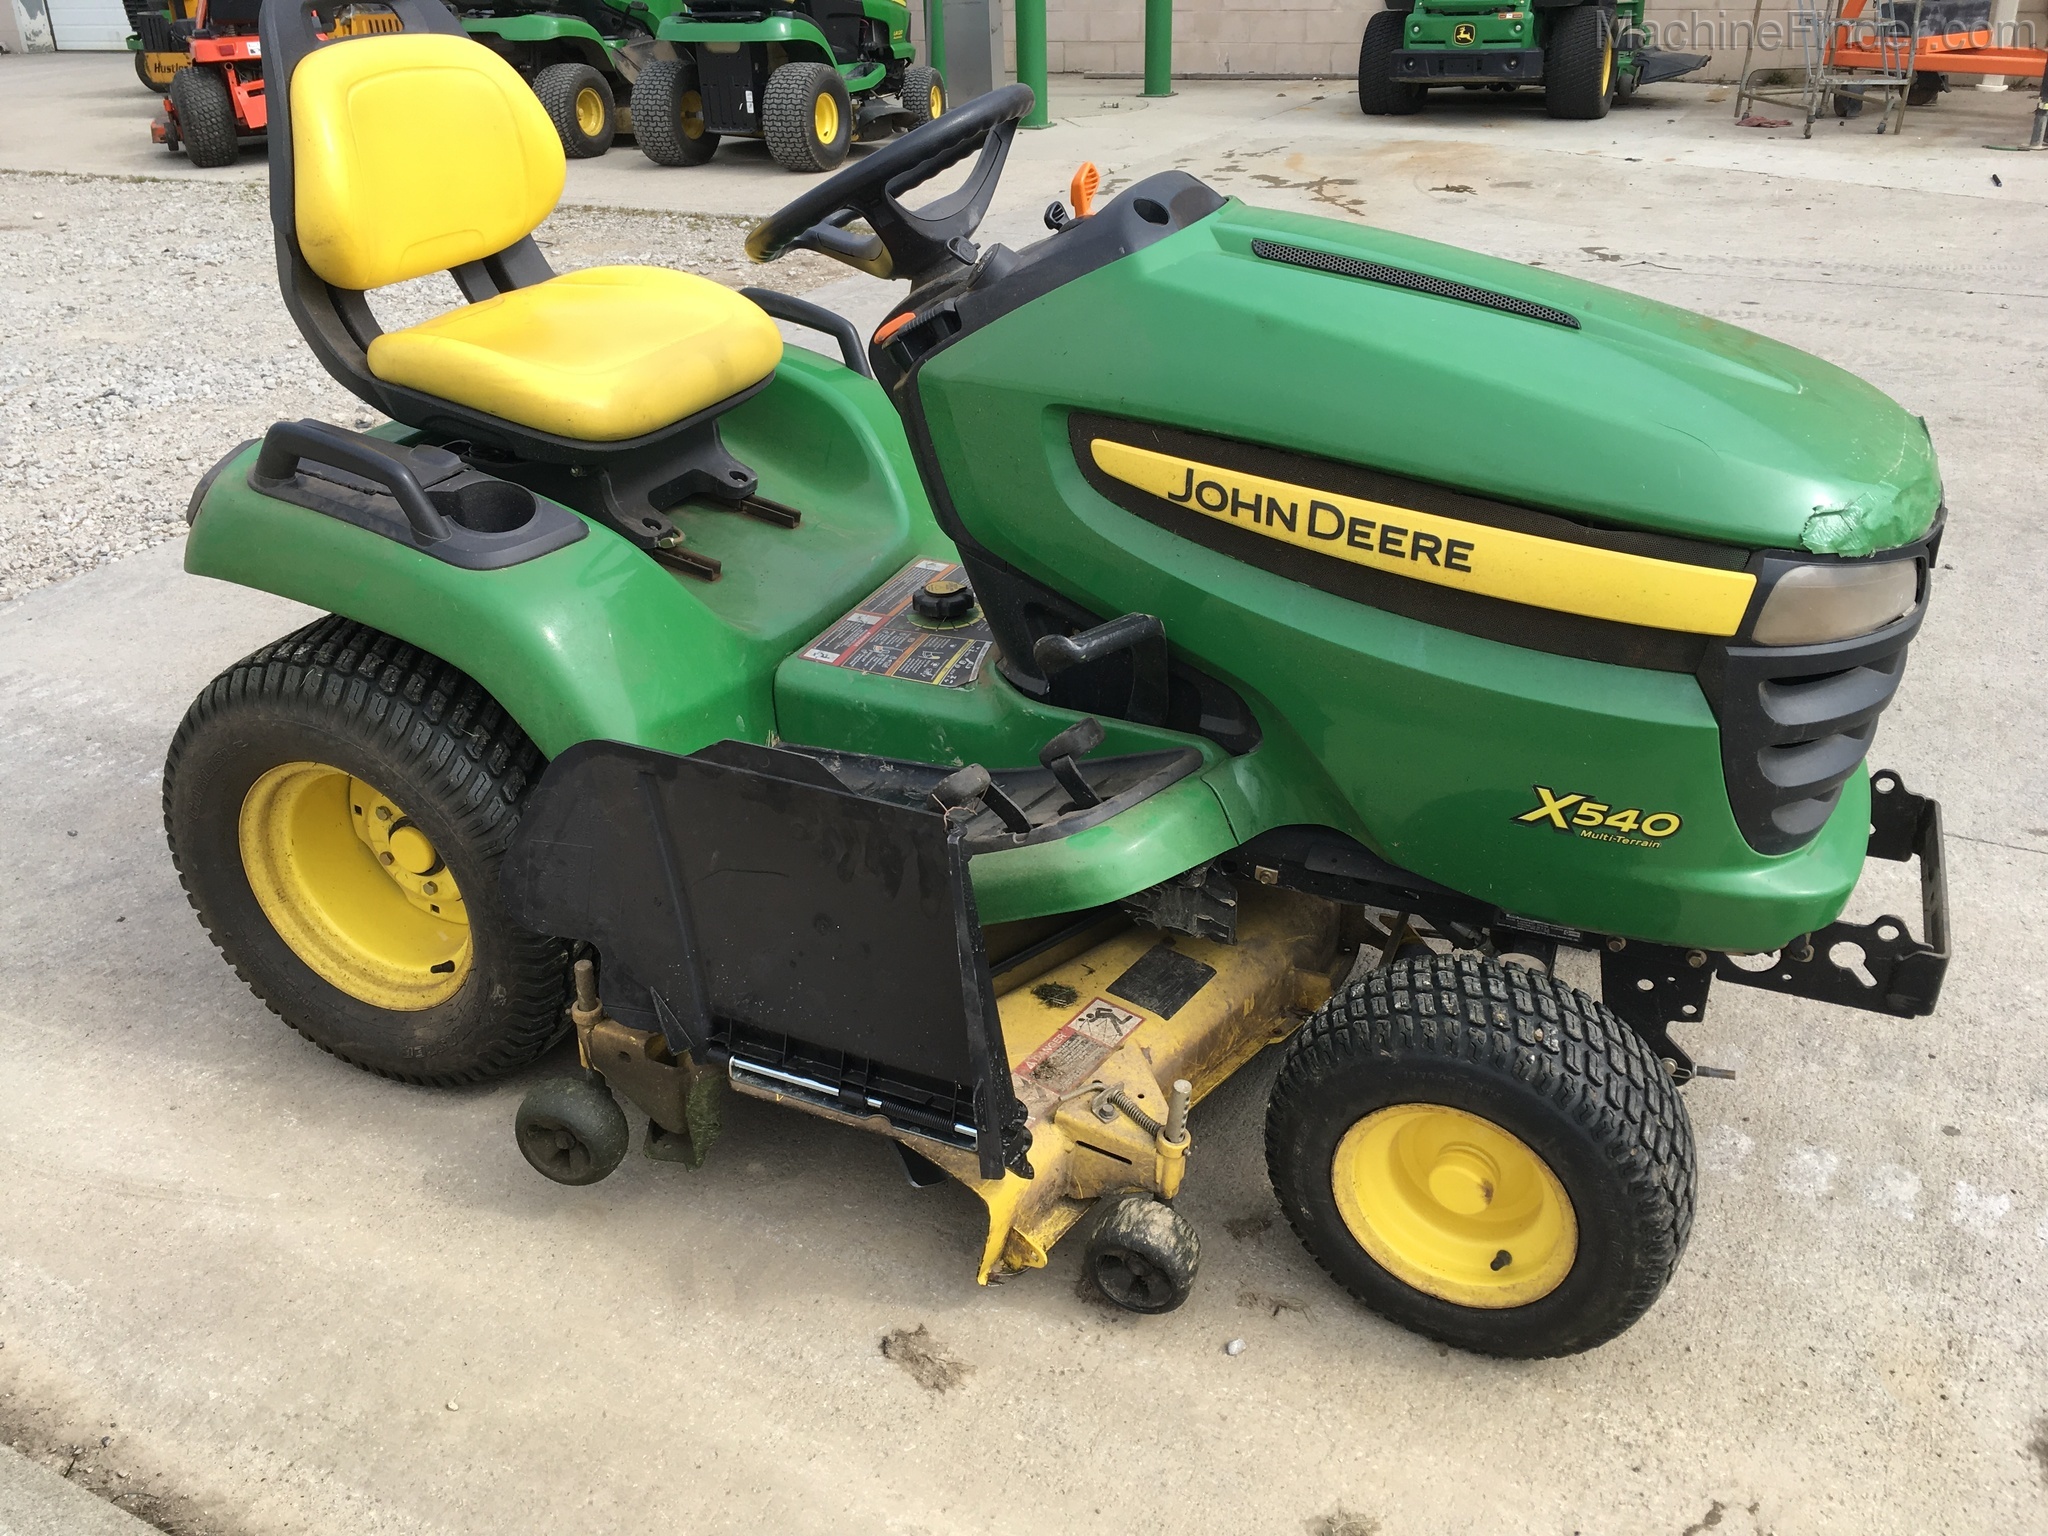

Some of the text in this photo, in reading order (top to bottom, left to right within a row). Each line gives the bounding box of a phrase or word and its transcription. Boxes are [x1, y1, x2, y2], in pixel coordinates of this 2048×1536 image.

[1168, 468, 1475, 573] JOHN DEERE
[1515, 786, 1682, 838] X540
[1580, 829, 1662, 849] Multi-Terrain
[1033, 1032, 1068, 1064] DANGER
